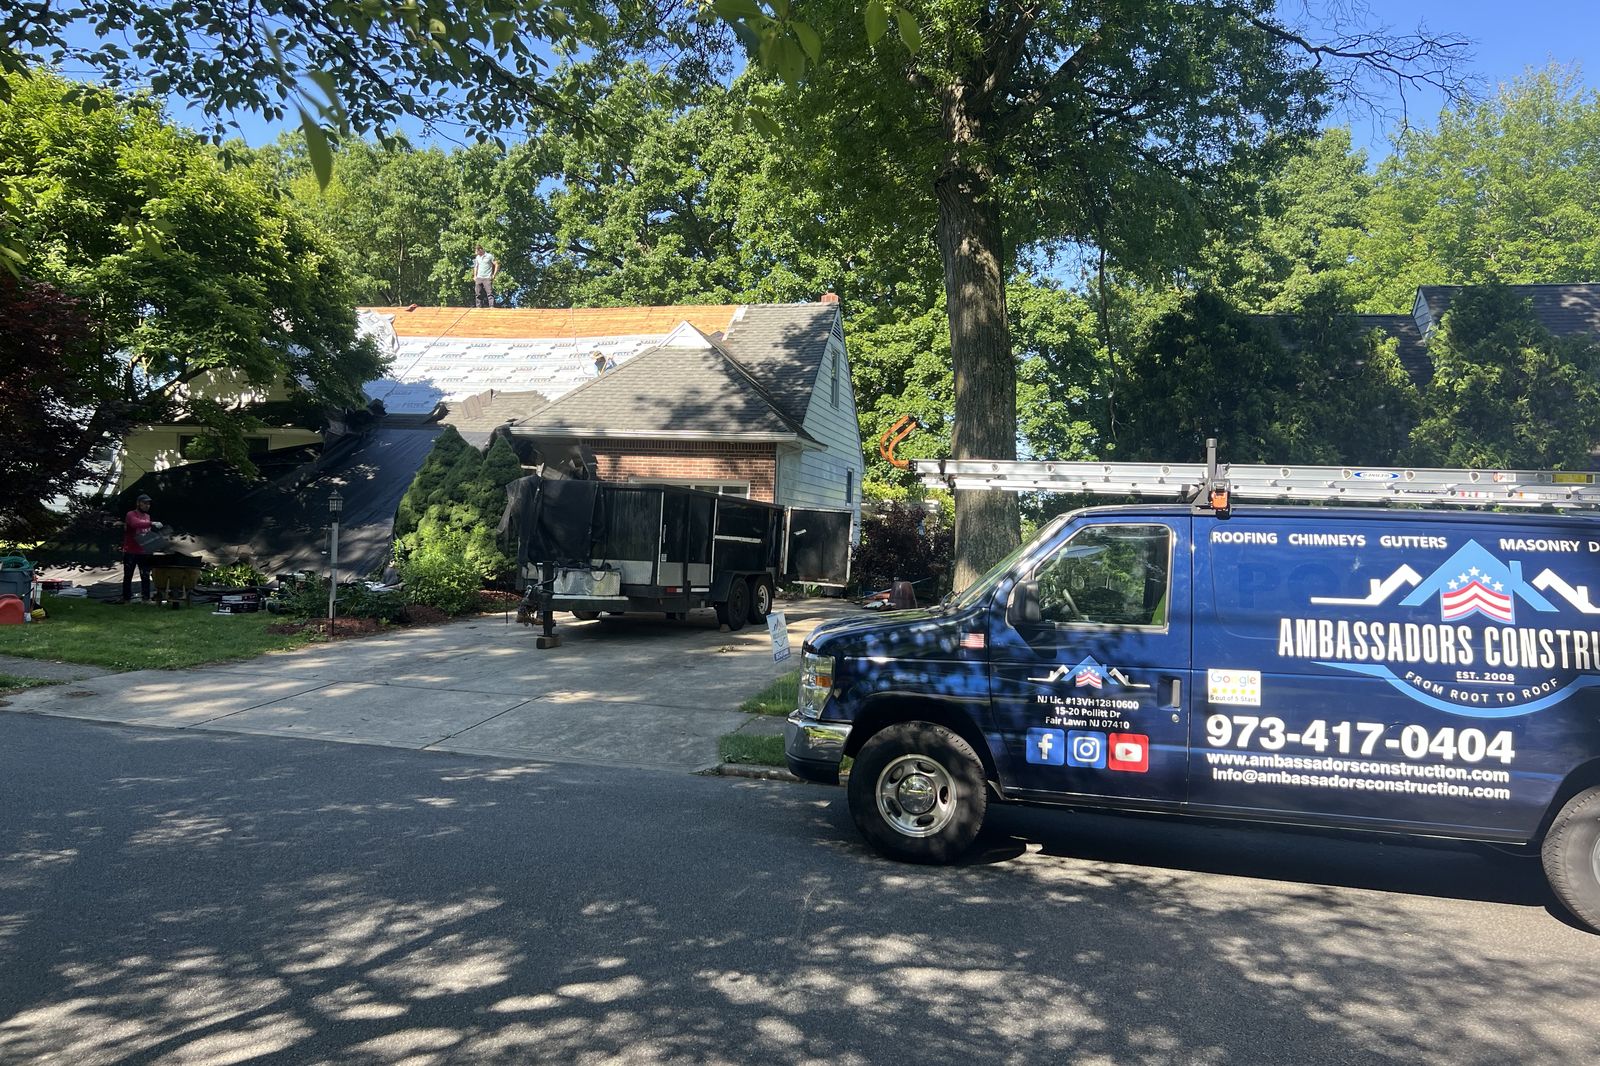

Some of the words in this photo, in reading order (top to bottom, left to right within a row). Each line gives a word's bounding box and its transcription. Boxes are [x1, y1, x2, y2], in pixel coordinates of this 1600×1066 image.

[1212, 531, 1278, 544] ROOFING
[1288, 533, 1366, 546] CHIMNEYS
[1380, 535, 1447, 548] GUTTERS
[1500, 538, 1580, 552] MASONRY
[1278, 618, 1474, 665] AMBASSADORS
[1456, 671, 1480, 680] EST.
[1484, 672, 1515, 682] 2008
[1405, 671, 1444, 695] FROM
[1450, 689, 1489, 704] ROOT
[1497, 692, 1516, 704] TO
[1522, 678, 1559, 699] ROOF
[1037, 695, 1047, 703] NJ
[1050, 696, 1064, 705] Lic.
[1055, 707, 1080, 716] 15-20
[1081, 709, 1109, 718] Pollitt
[1063, 717, 1087, 727] Lawn
[1089, 719, 1100, 727] NJ
[1101, 720, 1130, 729] 07410
[1206, 714, 1515, 763] 973-417-0404
[1206, 753, 1510, 783] www.ambassadorsconstruction.com
